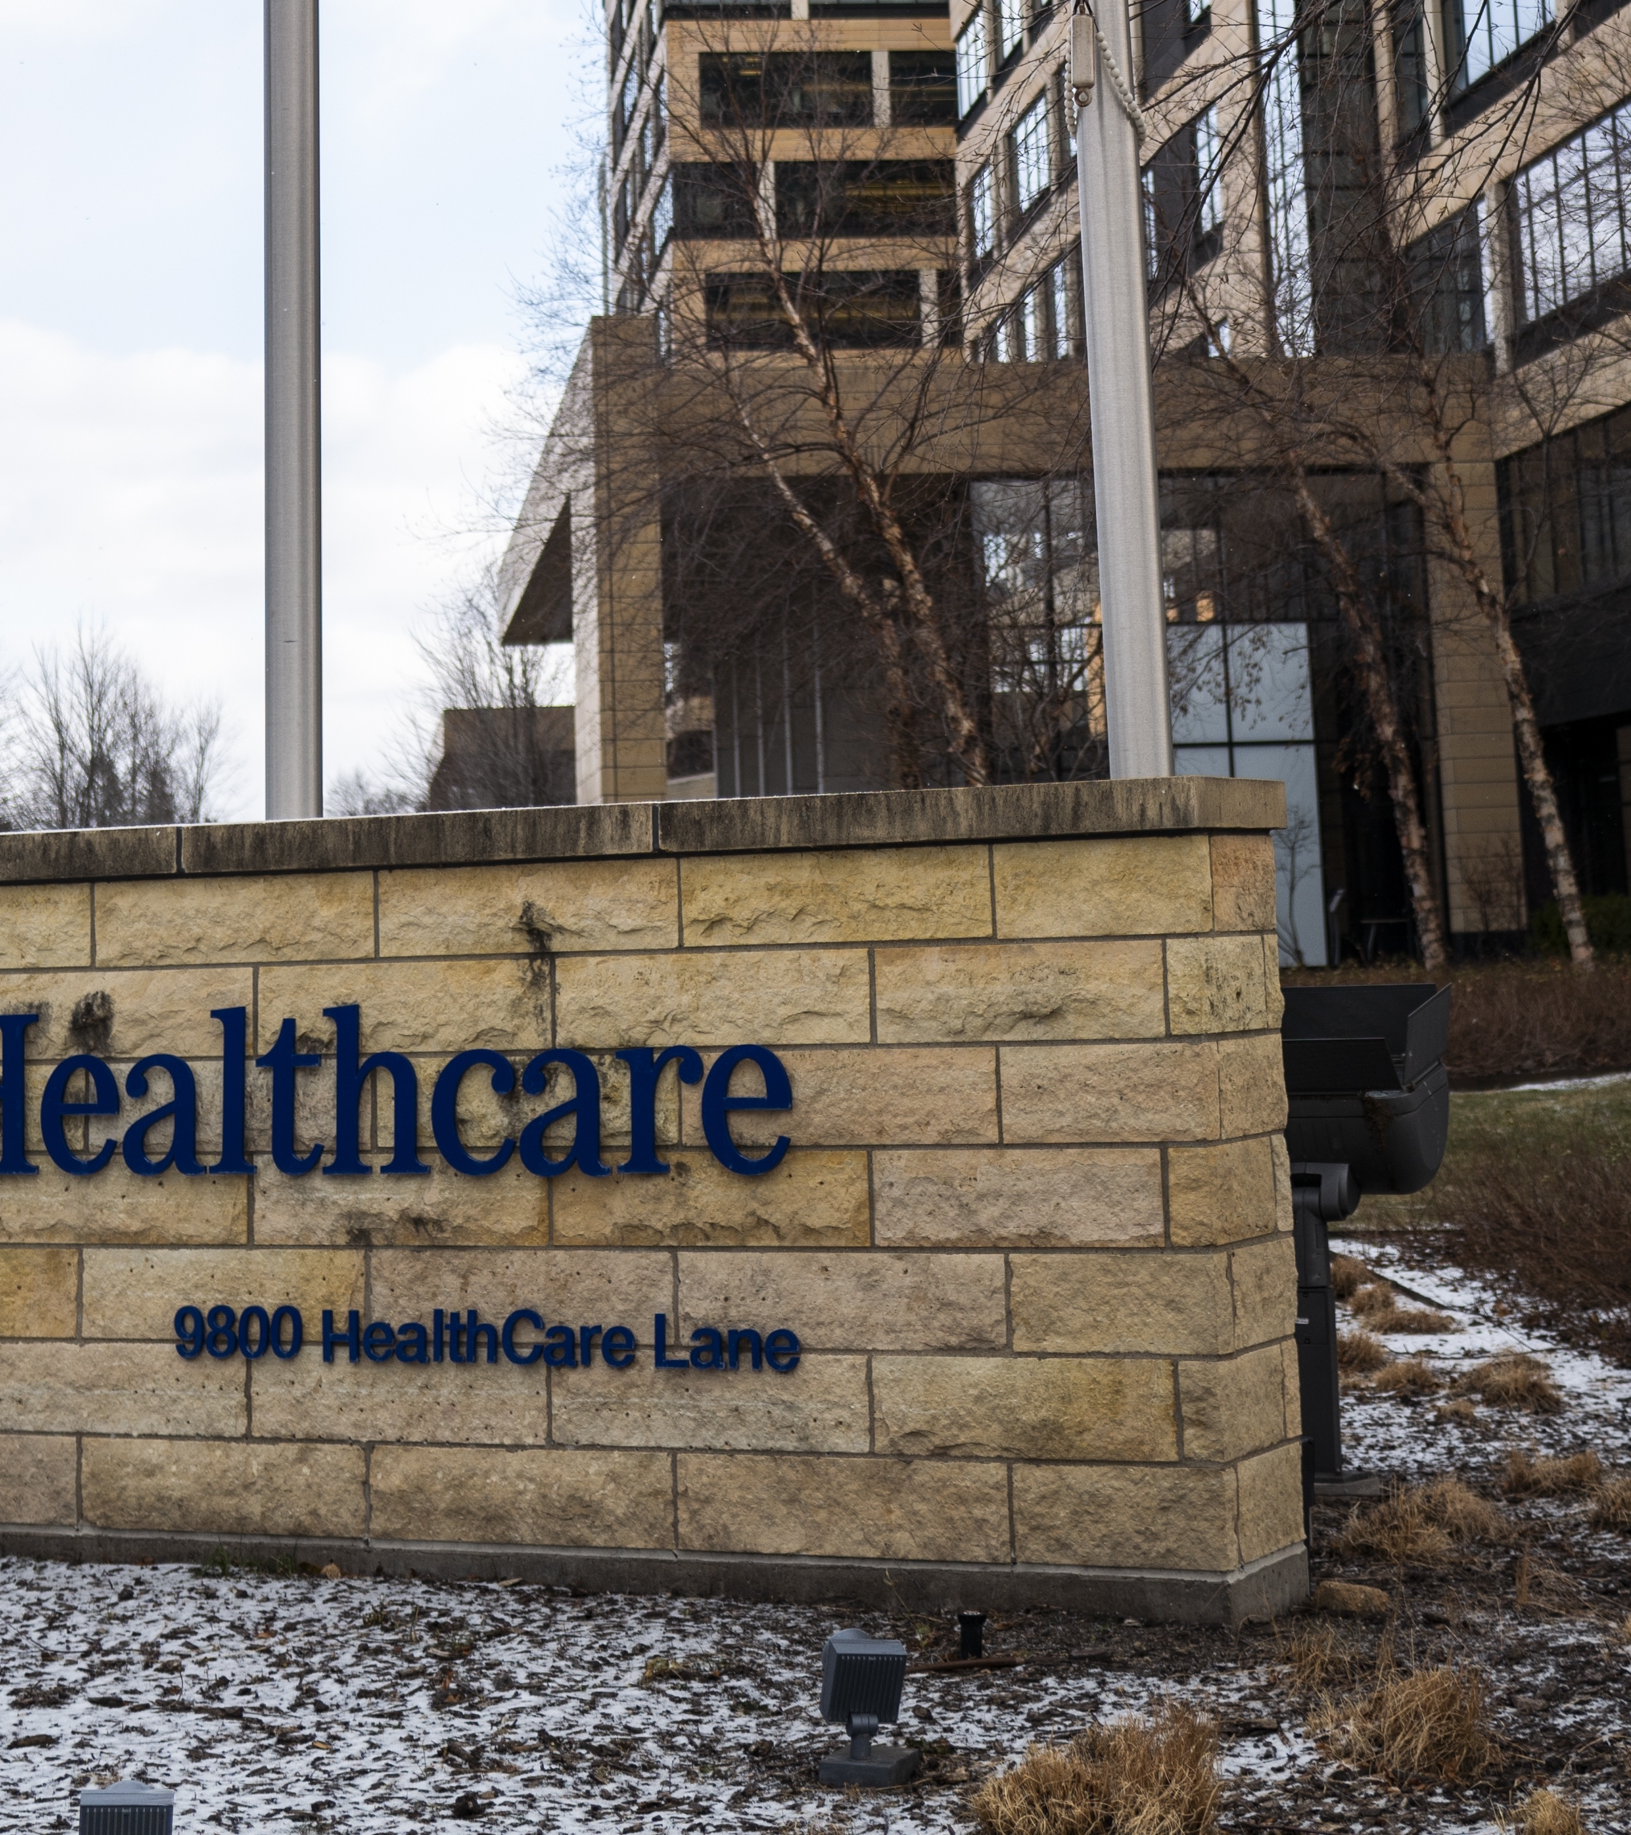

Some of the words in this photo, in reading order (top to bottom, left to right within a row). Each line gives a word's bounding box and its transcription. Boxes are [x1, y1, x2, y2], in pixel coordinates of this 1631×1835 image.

[173, 1304, 303, 1360] 9800
[322, 1308, 636, 1368] HealthCare
[654, 1312, 801, 1372] Lane
